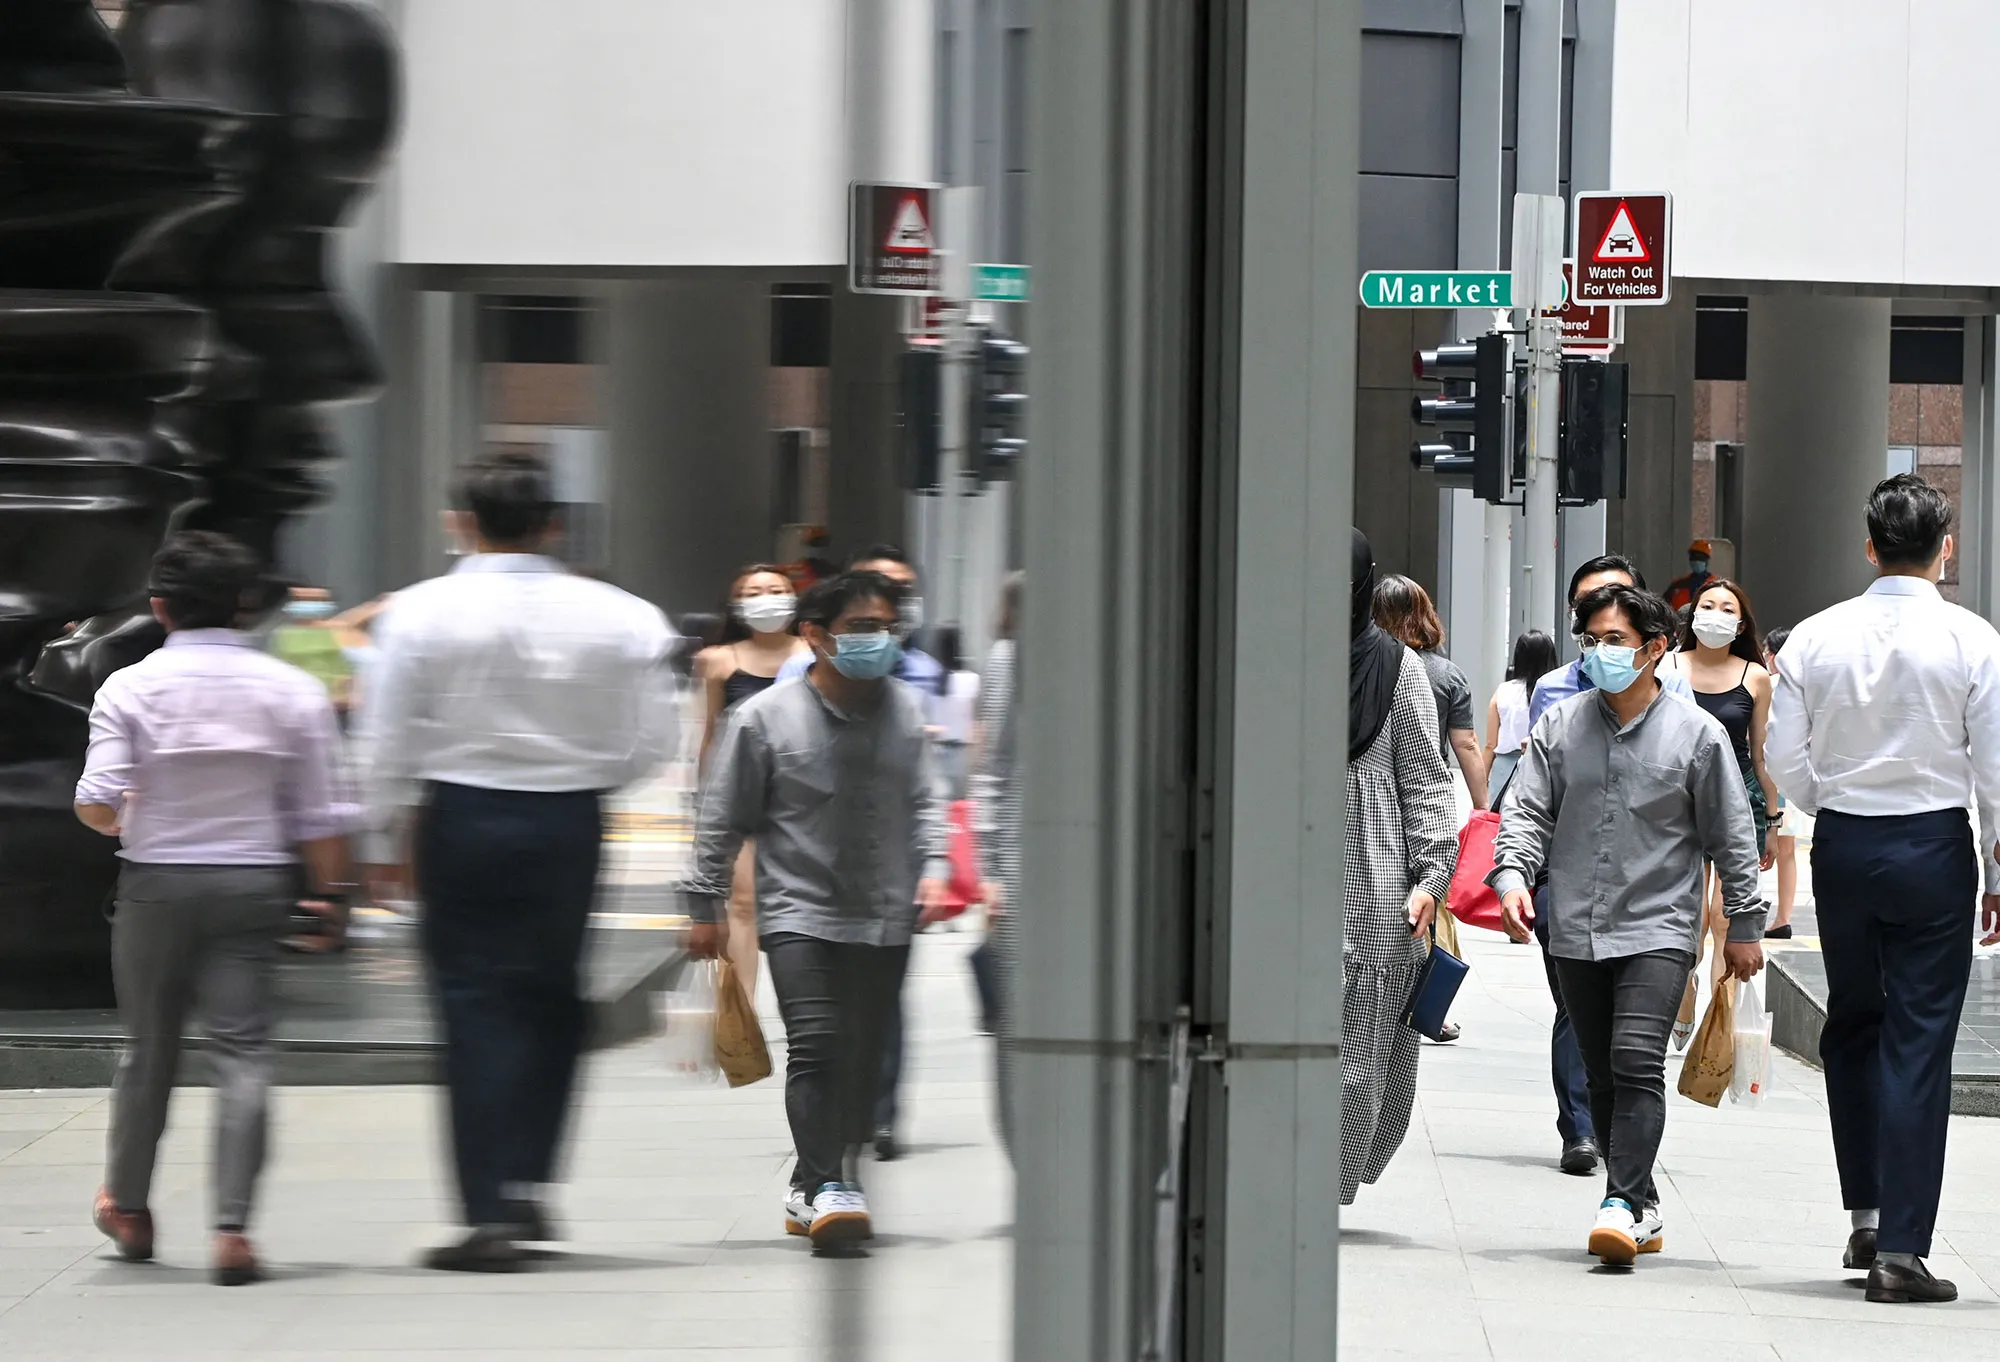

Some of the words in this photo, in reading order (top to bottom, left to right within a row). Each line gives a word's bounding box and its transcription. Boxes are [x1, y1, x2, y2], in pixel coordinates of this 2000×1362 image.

[1588, 266, 1625, 280] Watch
[1631, 266, 1653, 280] Out
[1379, 277, 1499, 303] Market
[1584, 282, 1603, 296] For
[1608, 282, 1657, 296] Vehicles
[1559, 320, 1589, 330] hared
